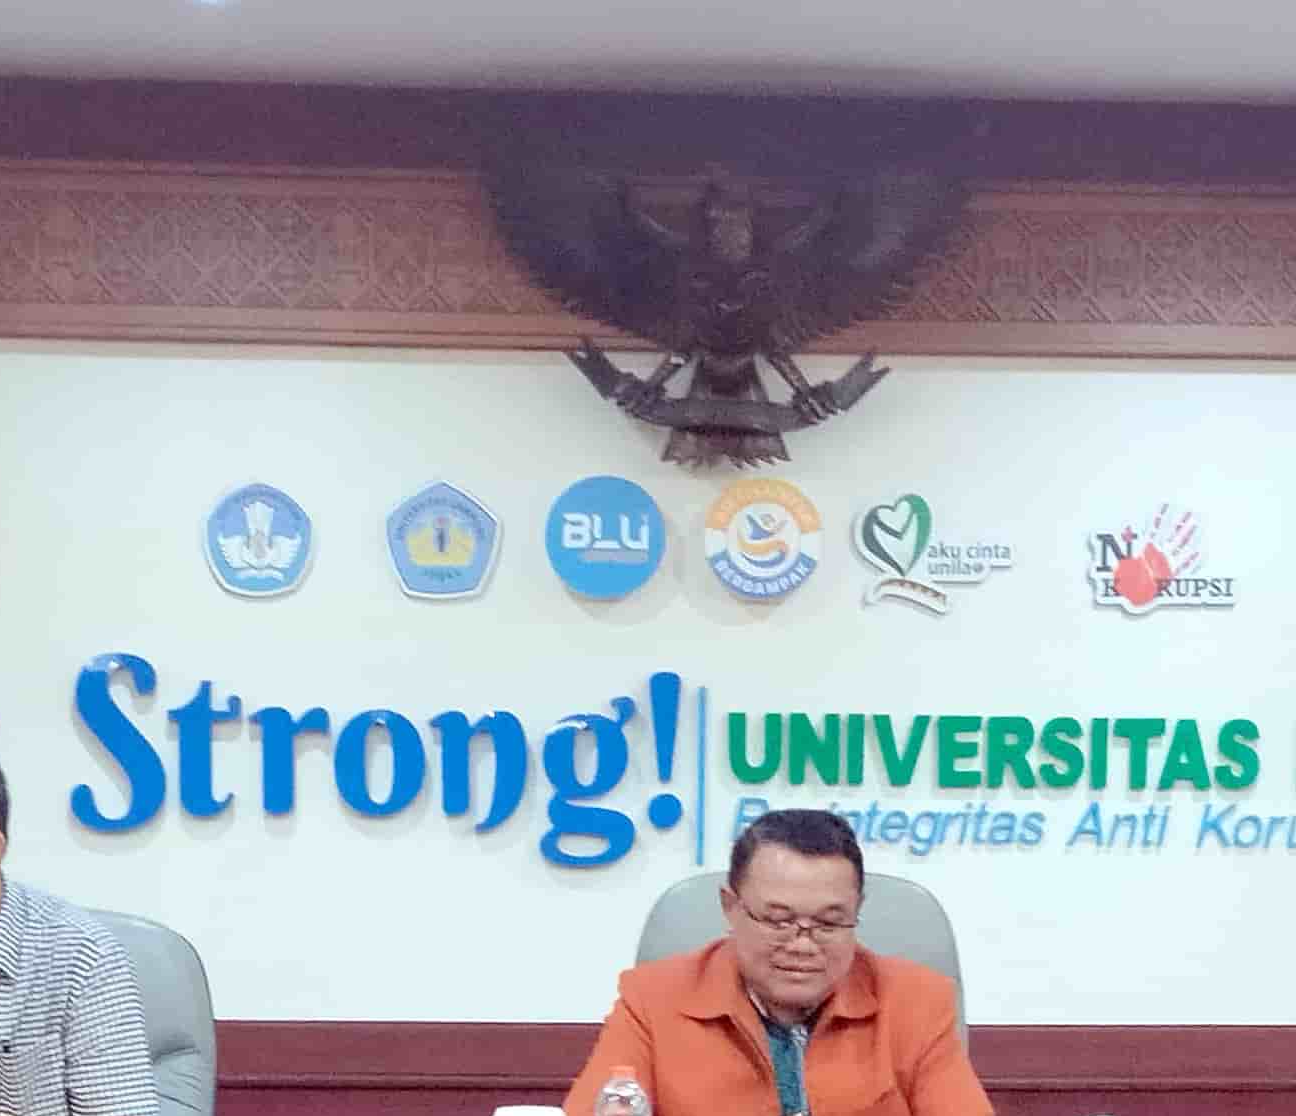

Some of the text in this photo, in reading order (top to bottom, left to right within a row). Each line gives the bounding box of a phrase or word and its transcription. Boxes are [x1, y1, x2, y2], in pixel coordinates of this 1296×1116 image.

[561, 511, 650, 550] BLU
[928, 541, 1012, 560] aku cinta
[1102, 577, 1234, 598] KRUPSI
[70, 653, 682, 868] Strong!
[727, 711, 1261, 791] UNIVERSITAS
[1066, 801, 1171, 849] Anti
